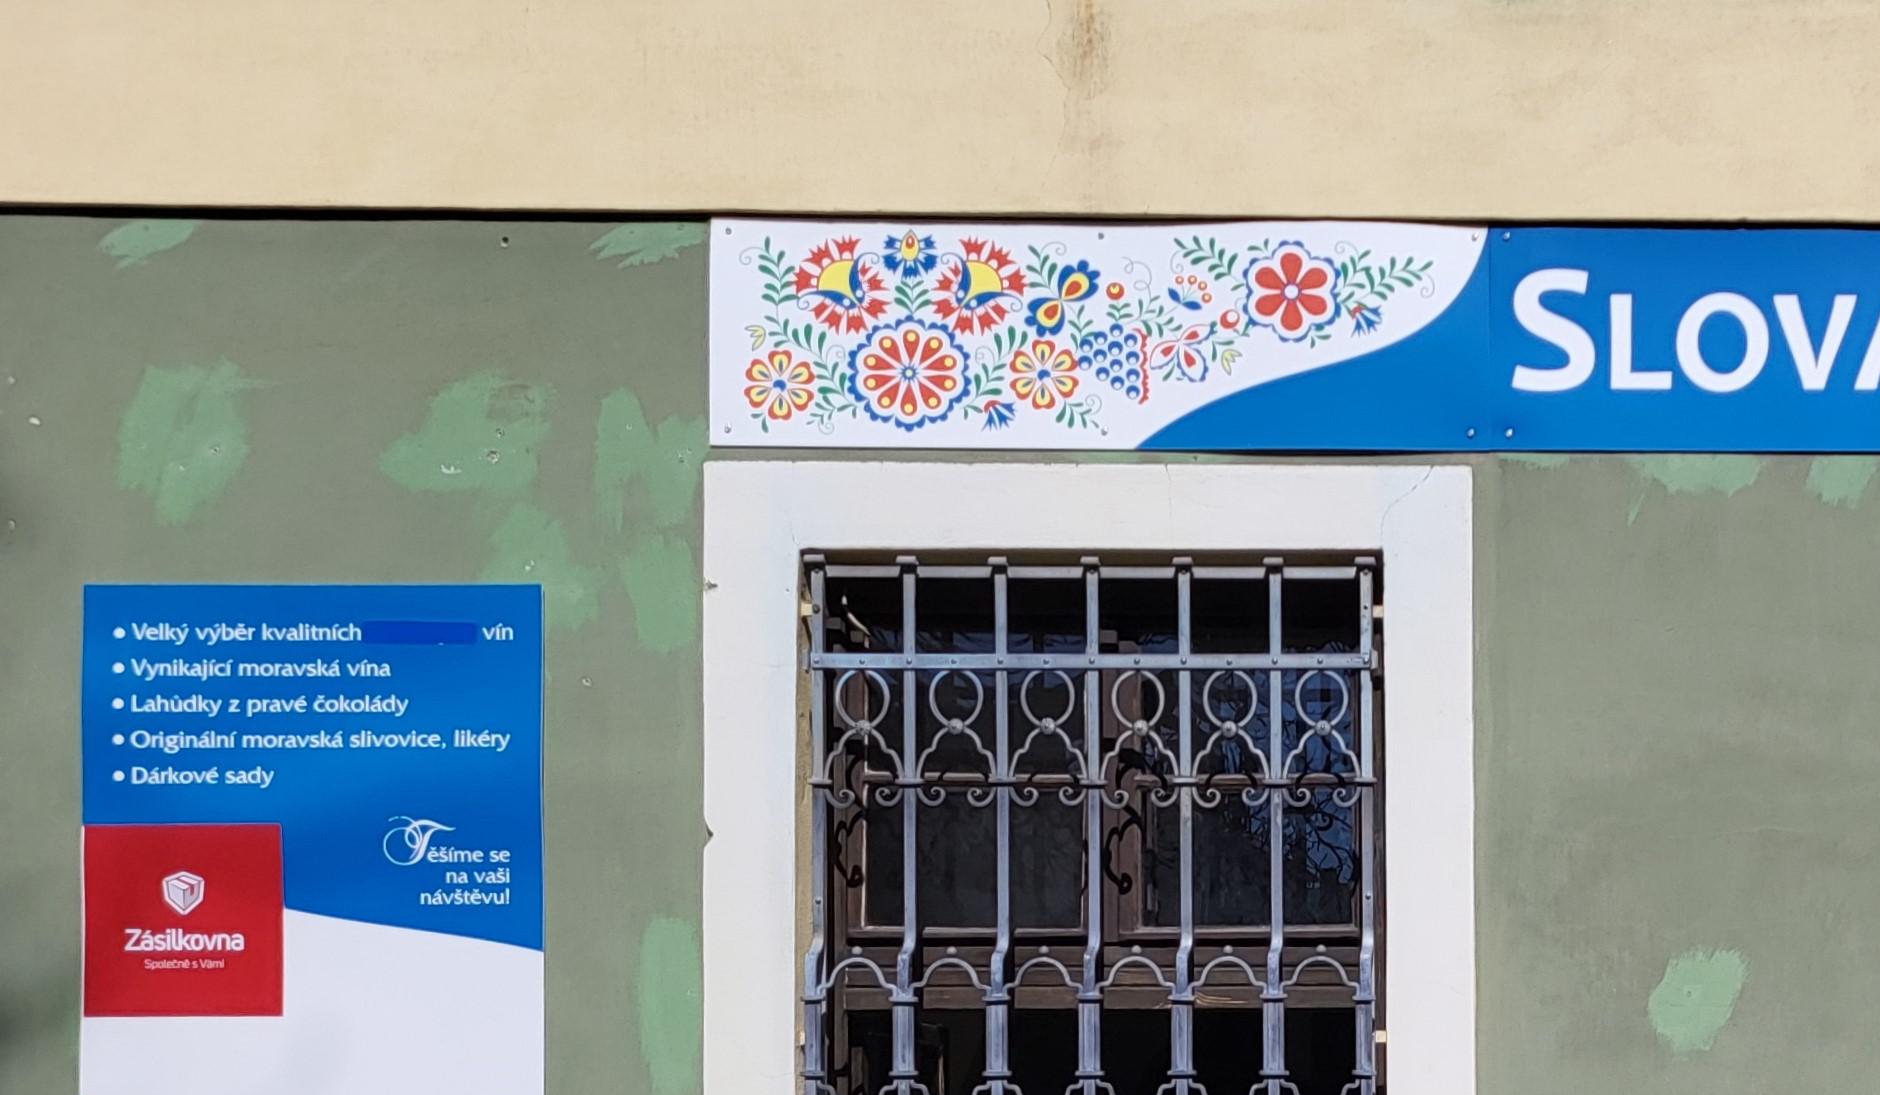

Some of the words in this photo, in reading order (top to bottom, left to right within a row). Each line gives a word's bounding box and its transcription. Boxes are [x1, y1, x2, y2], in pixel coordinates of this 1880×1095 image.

[131, 623, 189, 645] Velký
[195, 623, 256, 646] výběr
[261, 623, 362, 641] kvalitních
[482, 623, 514, 641] vín
[131, 658, 233, 681] Vynikající
[238, 658, 341, 677] moravská
[347, 659, 391, 677] vína
[228, 699, 241, 713] z
[247, 695, 308, 717] pravé
[313, 694, 409, 717] čokolády
[130, 730, 237, 754] Originální
[242, 730, 344, 749] moravská
[349, 730, 446, 752] slivovice,
[454, 729, 510, 752] likéry
[131, 766, 219, 785] Dárkové
[225, 766, 274, 789] sady
[489, 850, 511, 863] se
[446, 871, 469, 884] na
[474, 867, 510, 884] vaši
[420, 888, 510, 905] návštěvu!
[124, 928, 245, 952] Zásilkovna
